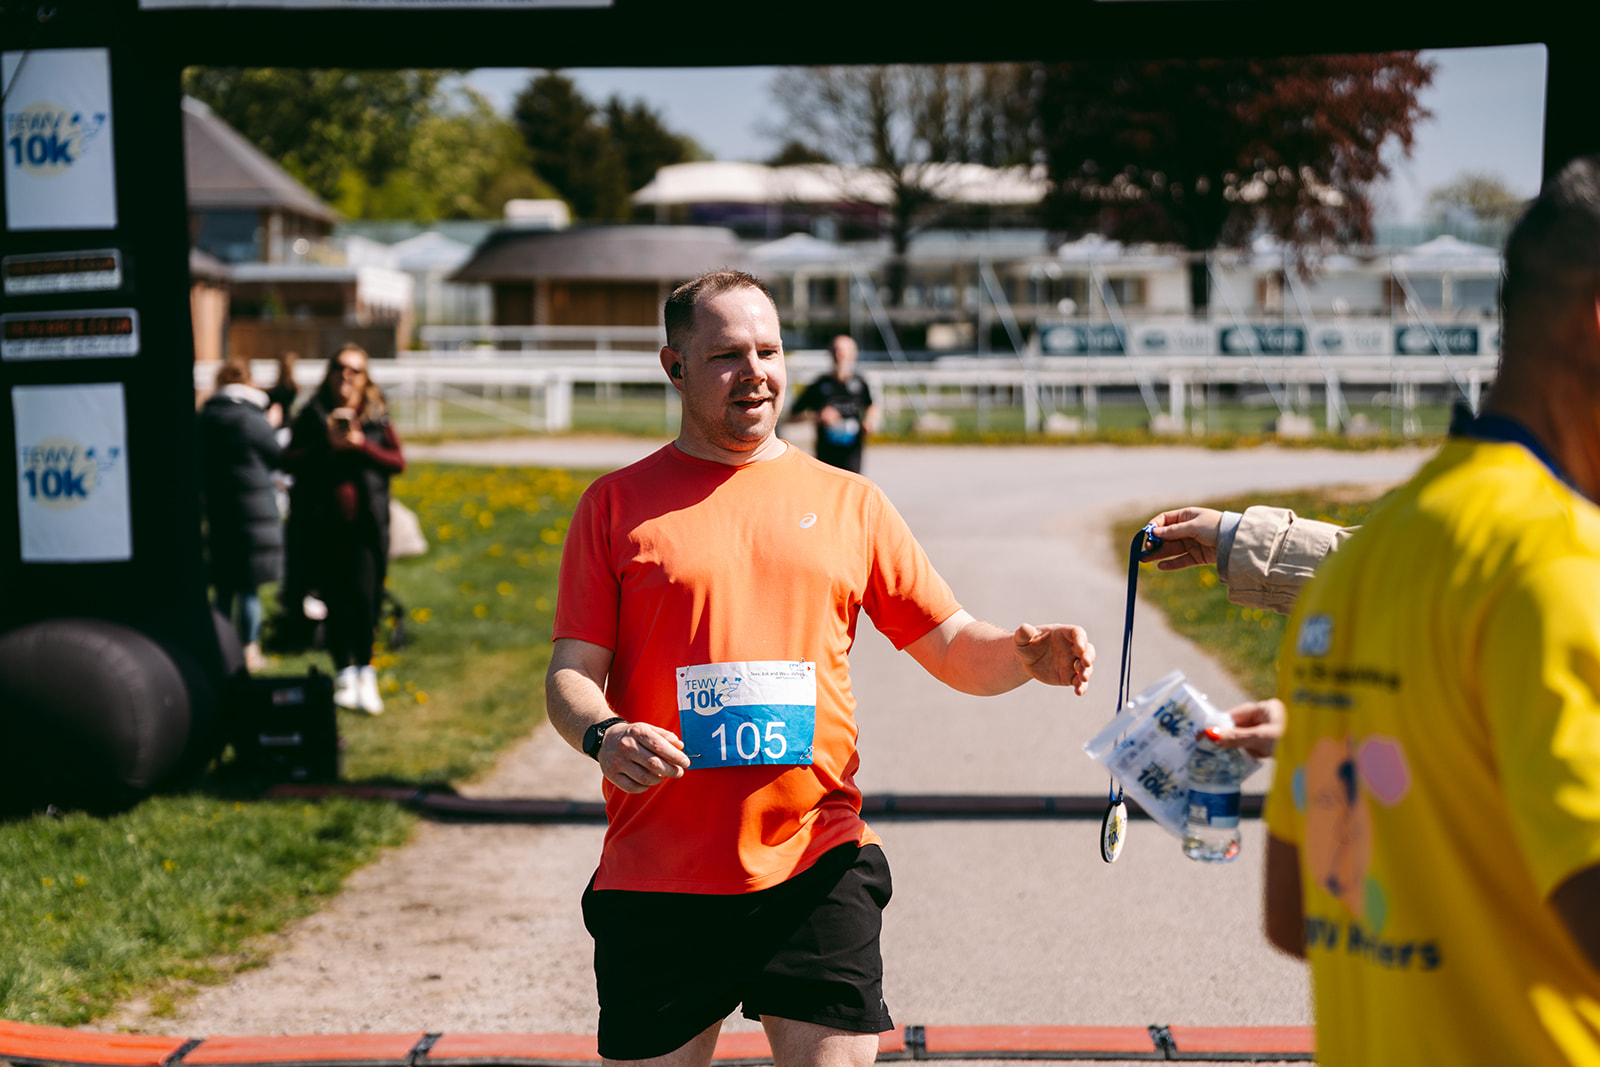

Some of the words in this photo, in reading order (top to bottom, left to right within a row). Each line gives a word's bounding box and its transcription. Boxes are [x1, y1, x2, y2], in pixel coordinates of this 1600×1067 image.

[7, 112, 64, 131] TEWV
[9, 132, 74, 167] 10k
[21, 446, 77, 463] TEWV
[23, 466, 88, 500] 10k
[685, 688, 725, 709] 10k
[686, 677, 718, 690] TEWV
[1153, 704, 1182, 737] 10k
[711, 721, 788, 761] 105
[1137, 768, 1169, 799] 10k
